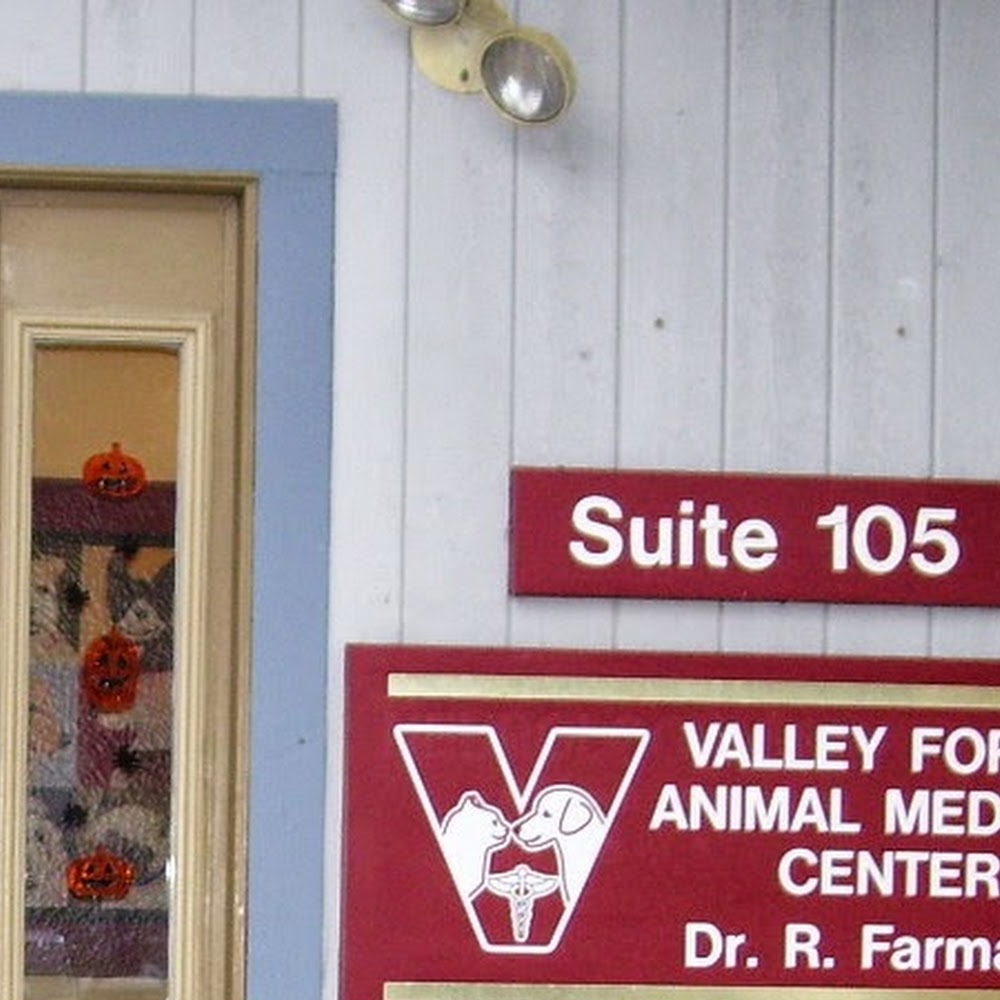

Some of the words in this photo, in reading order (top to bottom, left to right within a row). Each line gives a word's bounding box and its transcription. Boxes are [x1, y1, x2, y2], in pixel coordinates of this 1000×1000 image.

[568, 494, 780, 572] Suite
[815, 503, 962, 577] 105
[682, 720, 889, 773] VALLEY
[648, 783, 863, 835] ANIMAL
[883, 787, 1000, 838] MED
[777, 846, 1000, 899] CENTER
[683, 921, 759, 970] Dr.
[783, 922, 837, 970] R.
[860, 923, 1000, 973] Farm
